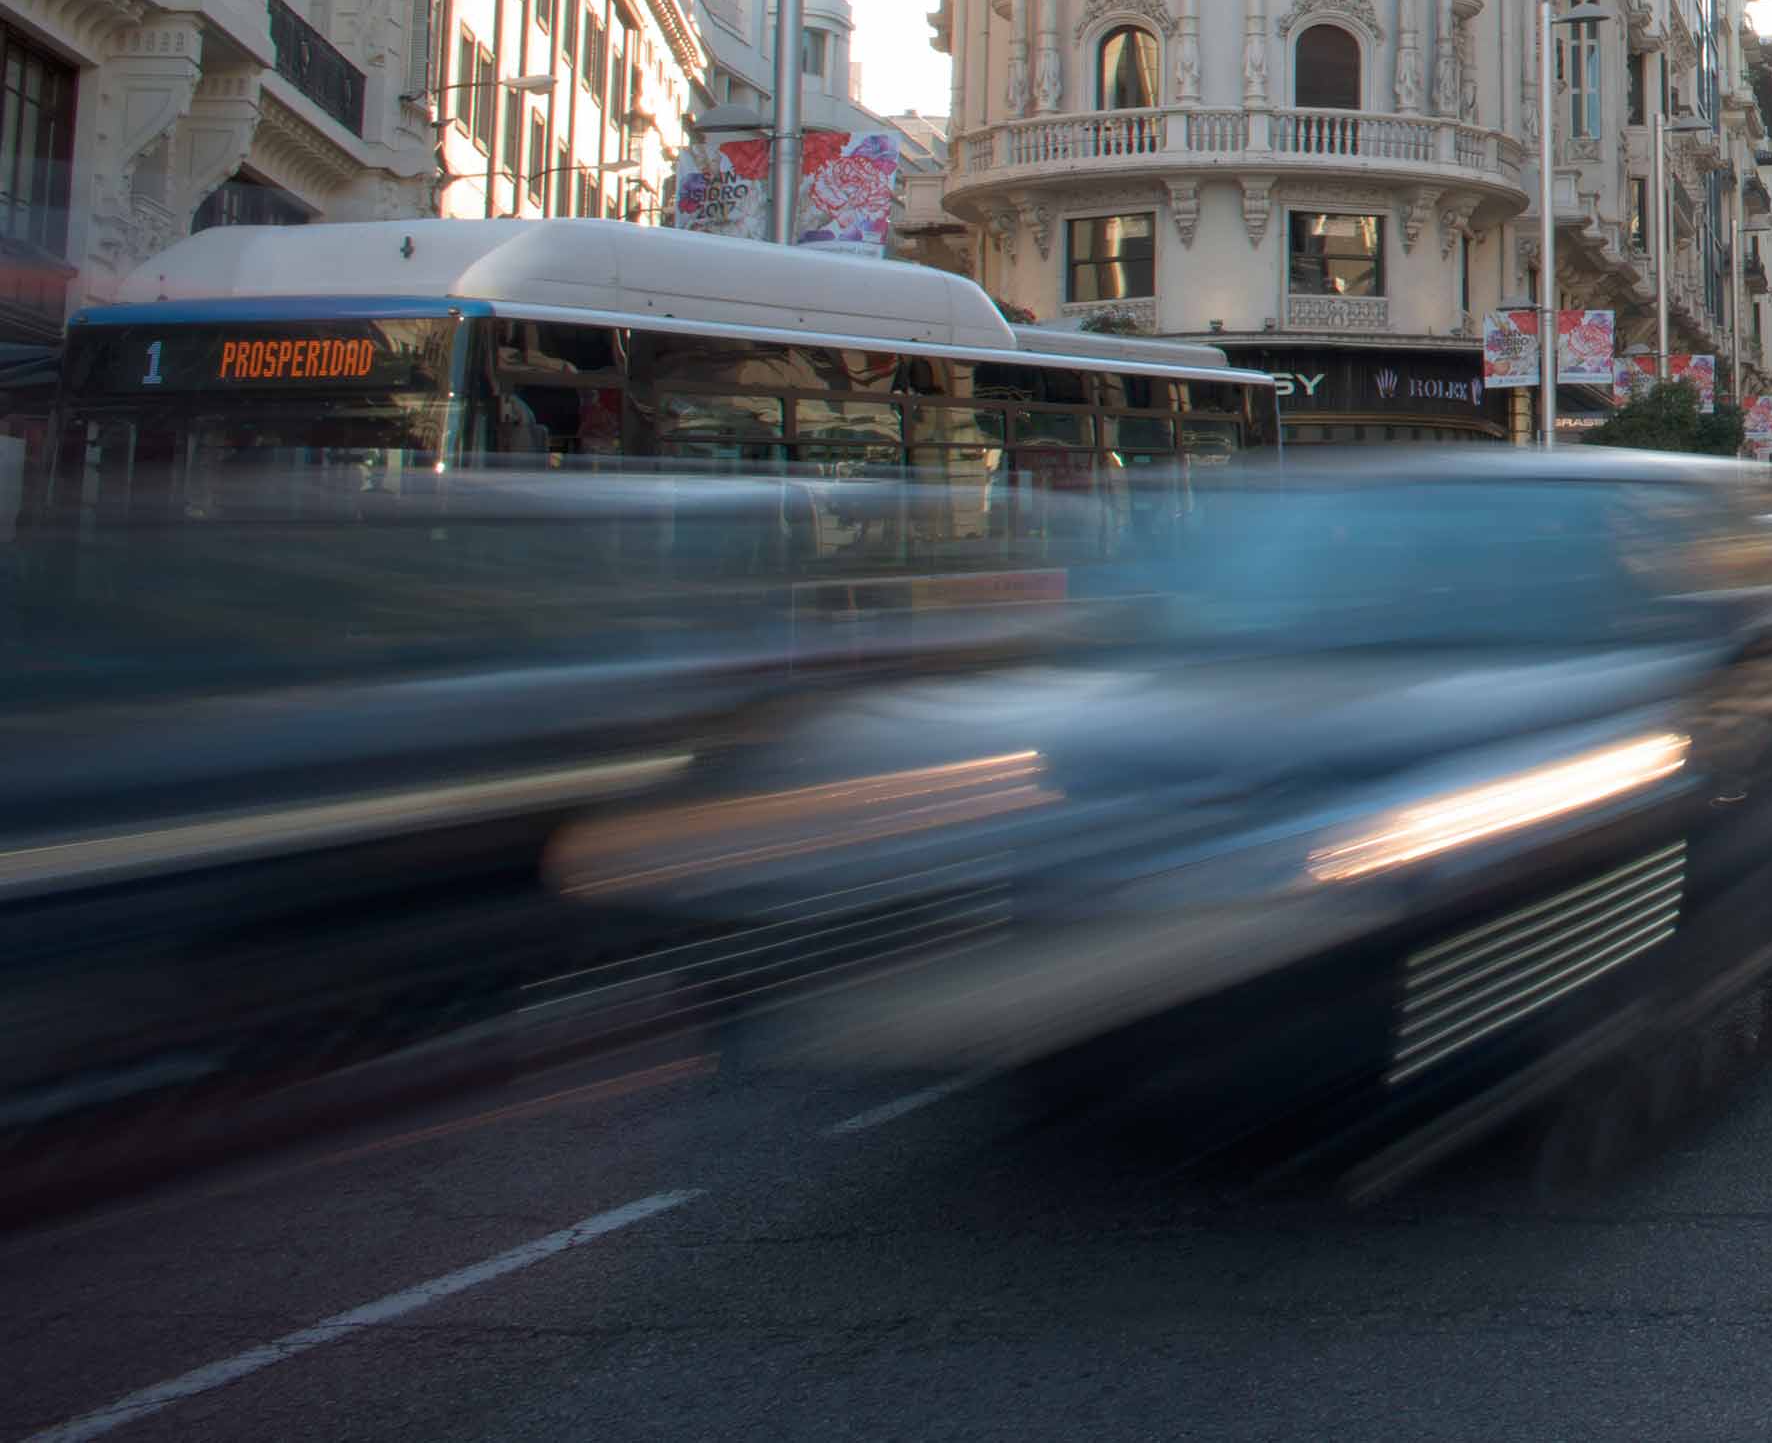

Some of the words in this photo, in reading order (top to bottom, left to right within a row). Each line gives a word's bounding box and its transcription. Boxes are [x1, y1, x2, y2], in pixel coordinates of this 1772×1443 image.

[704, 166, 738, 185] SAN
[687, 184, 748, 203] ISIDRO
[696, 201, 737, 220] 2017
[142, 341, 162, 384] 1
[219, 339, 374, 378] PROSPERIDAD
[1408, 377, 1468, 401] ROLEX
